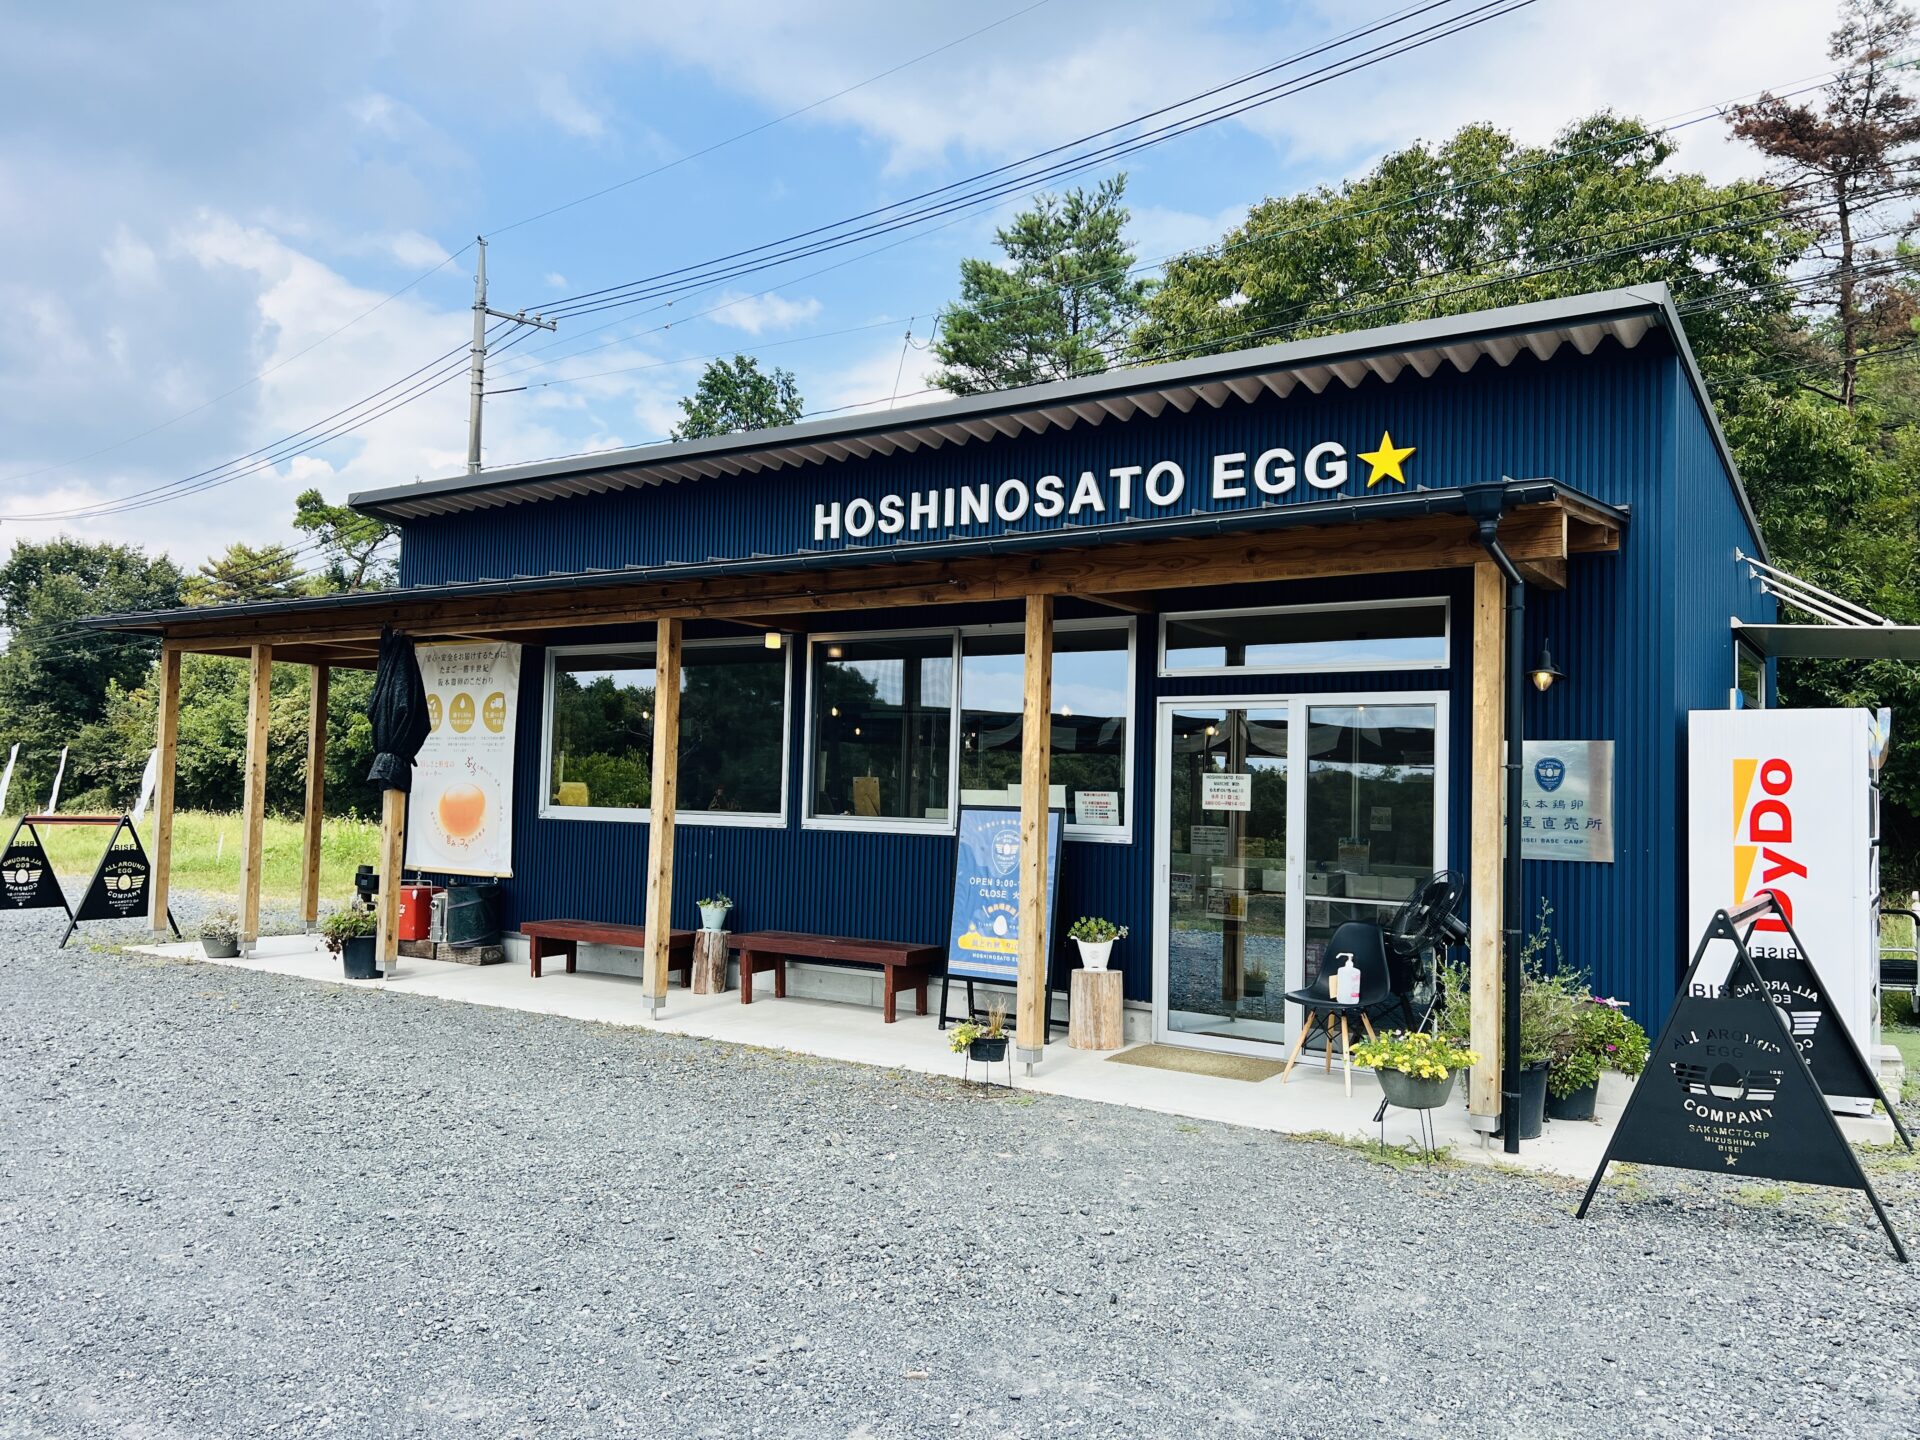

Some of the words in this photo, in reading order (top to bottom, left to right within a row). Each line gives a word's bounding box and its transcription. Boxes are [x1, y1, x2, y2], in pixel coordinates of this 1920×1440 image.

[813, 460, 1185, 541] HOSHINOSATO
[1212, 441, 1348, 499] EGG
[1750, 758, 1807, 932] DyDo
[969, 876, 993, 886] OPEN
[980, 888, 1007, 899] CLOSE
[1706, 1045, 1744, 1059] EGG
[1683, 1098, 1775, 1124] COMPANY
[1703, 1135, 1757, 1147] MIZUSHIMA
[1718, 1144, 1744, 1153] BISEI
